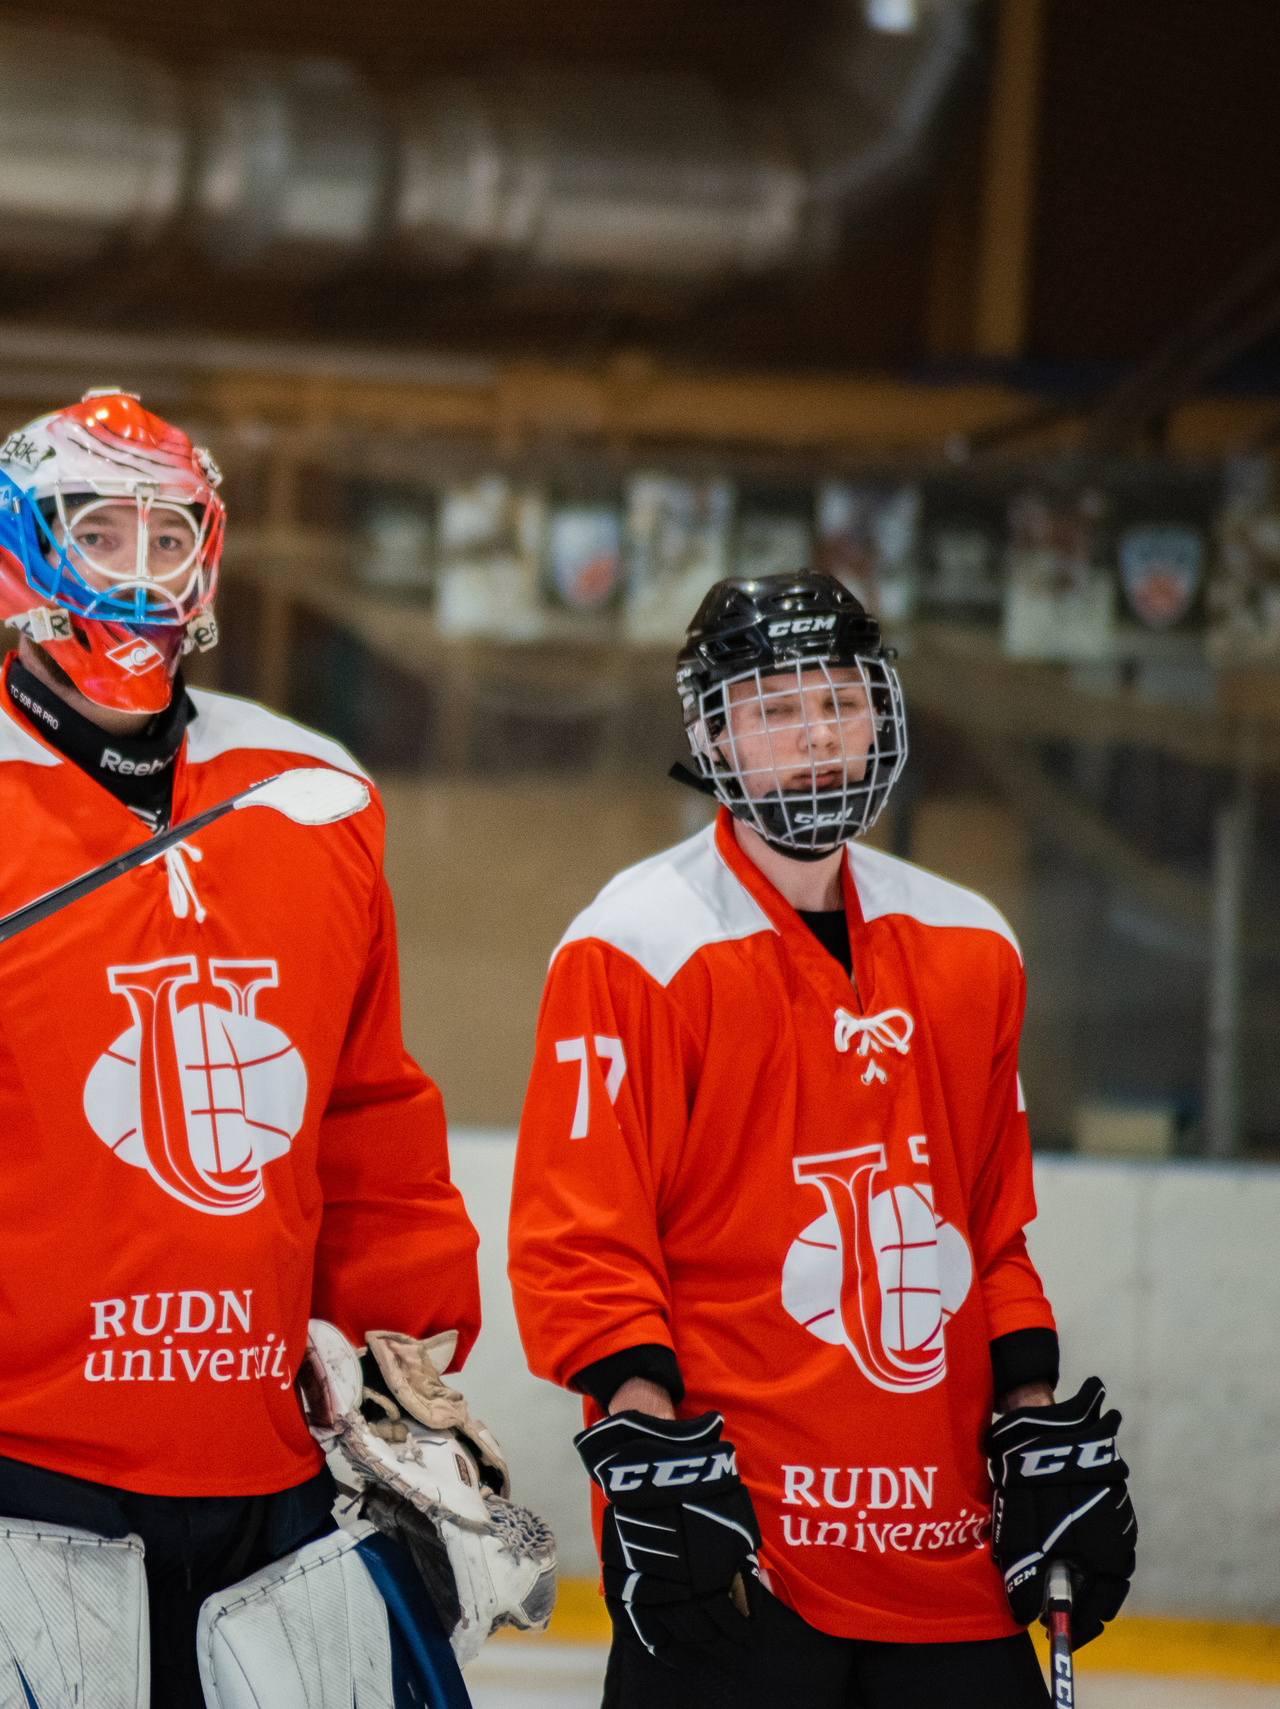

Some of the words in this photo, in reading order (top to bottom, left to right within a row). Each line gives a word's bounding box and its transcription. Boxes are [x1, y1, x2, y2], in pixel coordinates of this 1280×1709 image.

[768, 615, 837, 637] CCM
[43, 710, 58, 730] PRO
[554, 1034, 628, 1140] 77
[89, 1289, 253, 1341] RUDN
[607, 1450, 739, 1492] CCM
[1020, 1437, 1120, 1477] CC
[780, 1464, 938, 1510] RUDN
[1007, 1565, 1037, 1594] CCM
